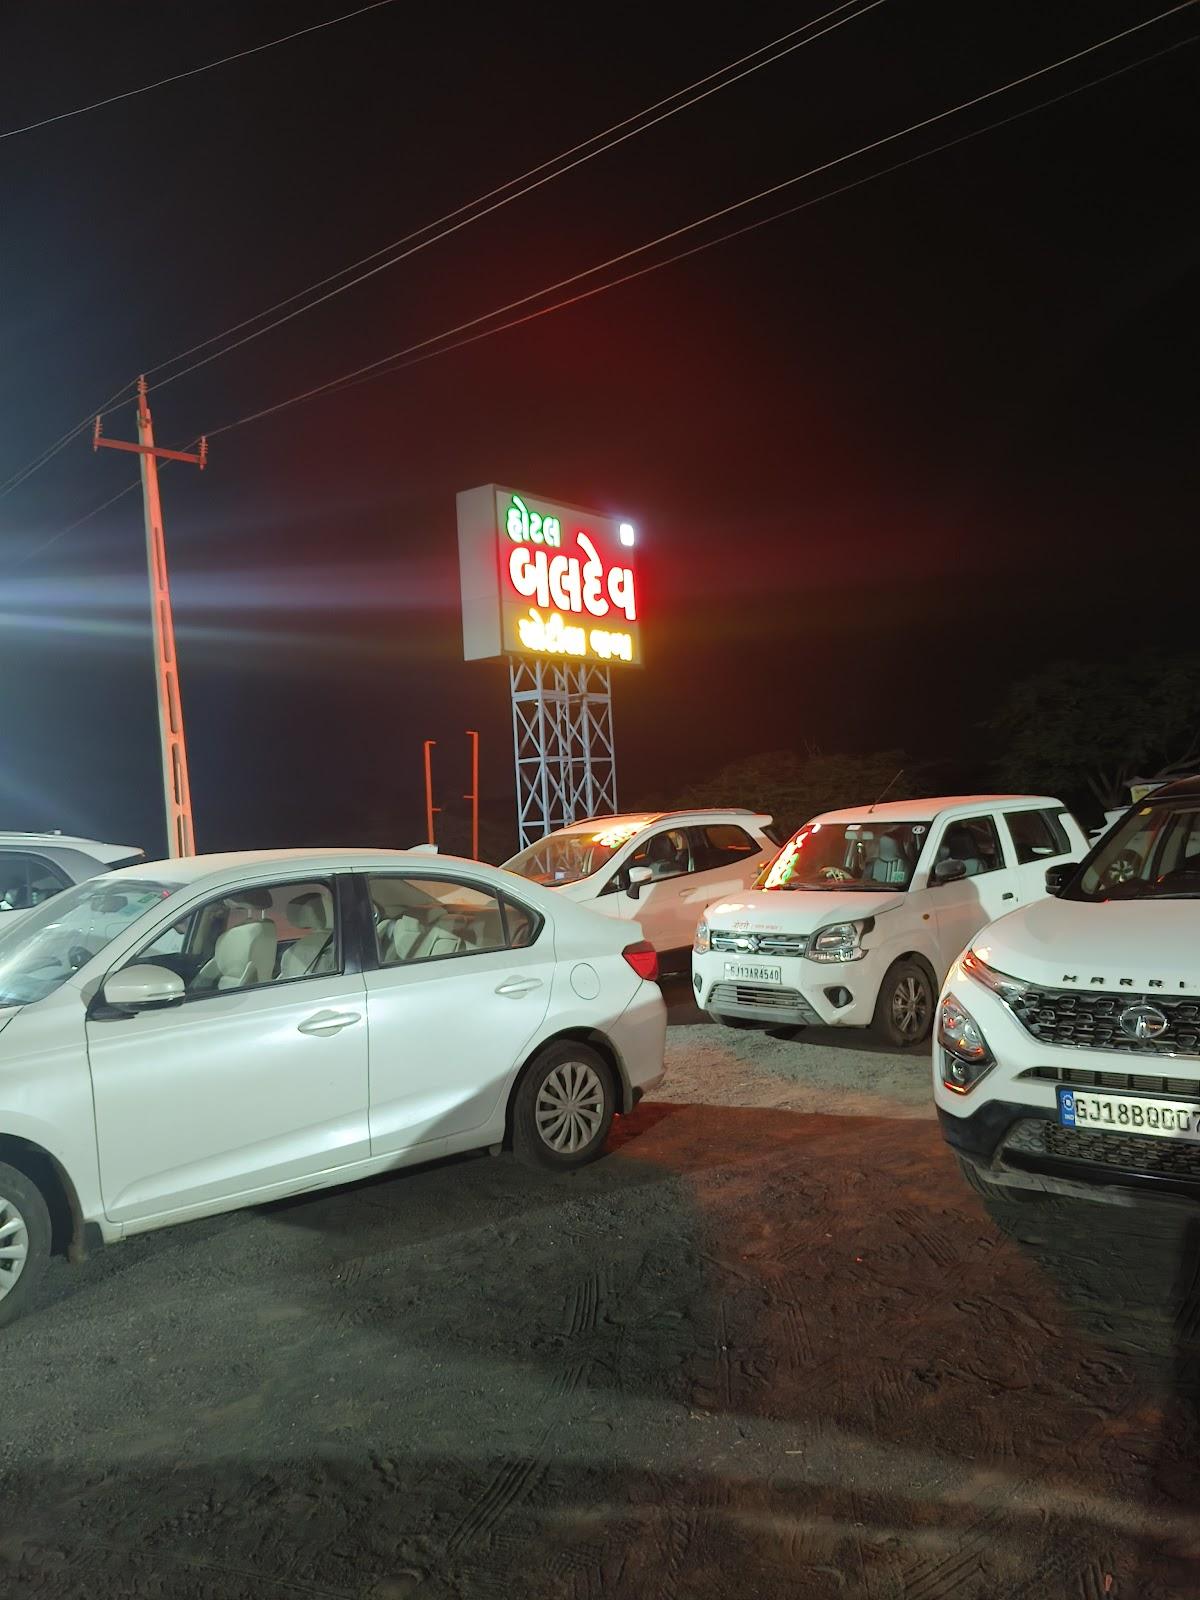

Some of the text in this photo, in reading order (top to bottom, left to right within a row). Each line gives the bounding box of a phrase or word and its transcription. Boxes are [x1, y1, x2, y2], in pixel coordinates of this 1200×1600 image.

[507, 495, 561, 548] હોટલ
[509, 532, 637, 621] બલદેવ
[730, 966, 780, 981] GJ13AR4540
